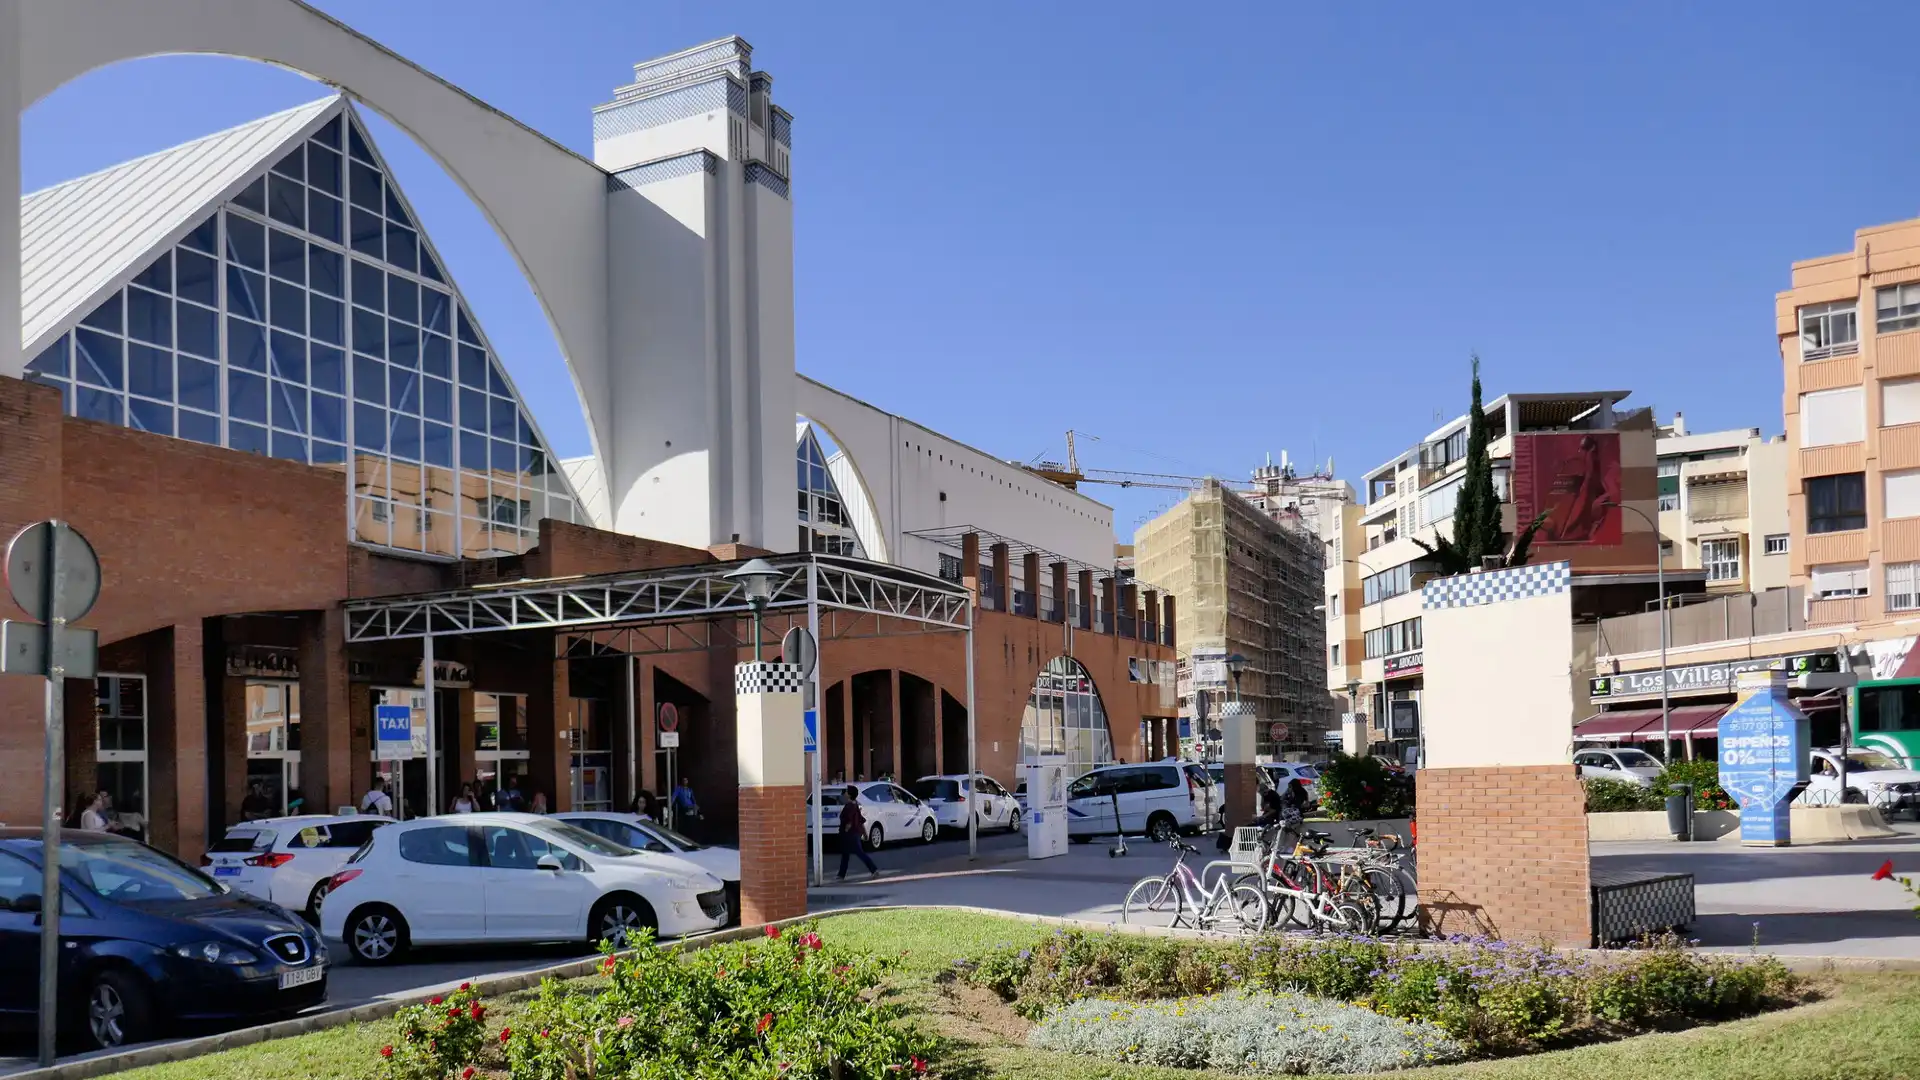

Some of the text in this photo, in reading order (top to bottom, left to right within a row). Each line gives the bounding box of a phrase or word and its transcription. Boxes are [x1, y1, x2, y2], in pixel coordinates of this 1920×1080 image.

[1792, 657, 1807, 671] VS
[1630, 675, 1663, 688] Los
[380, 717, 409, 730] TAXI
[1271, 727, 1288, 736] STOP
[1724, 733, 1791, 748] EMPEÑOS
[1724, 749, 1756, 765] 0%
